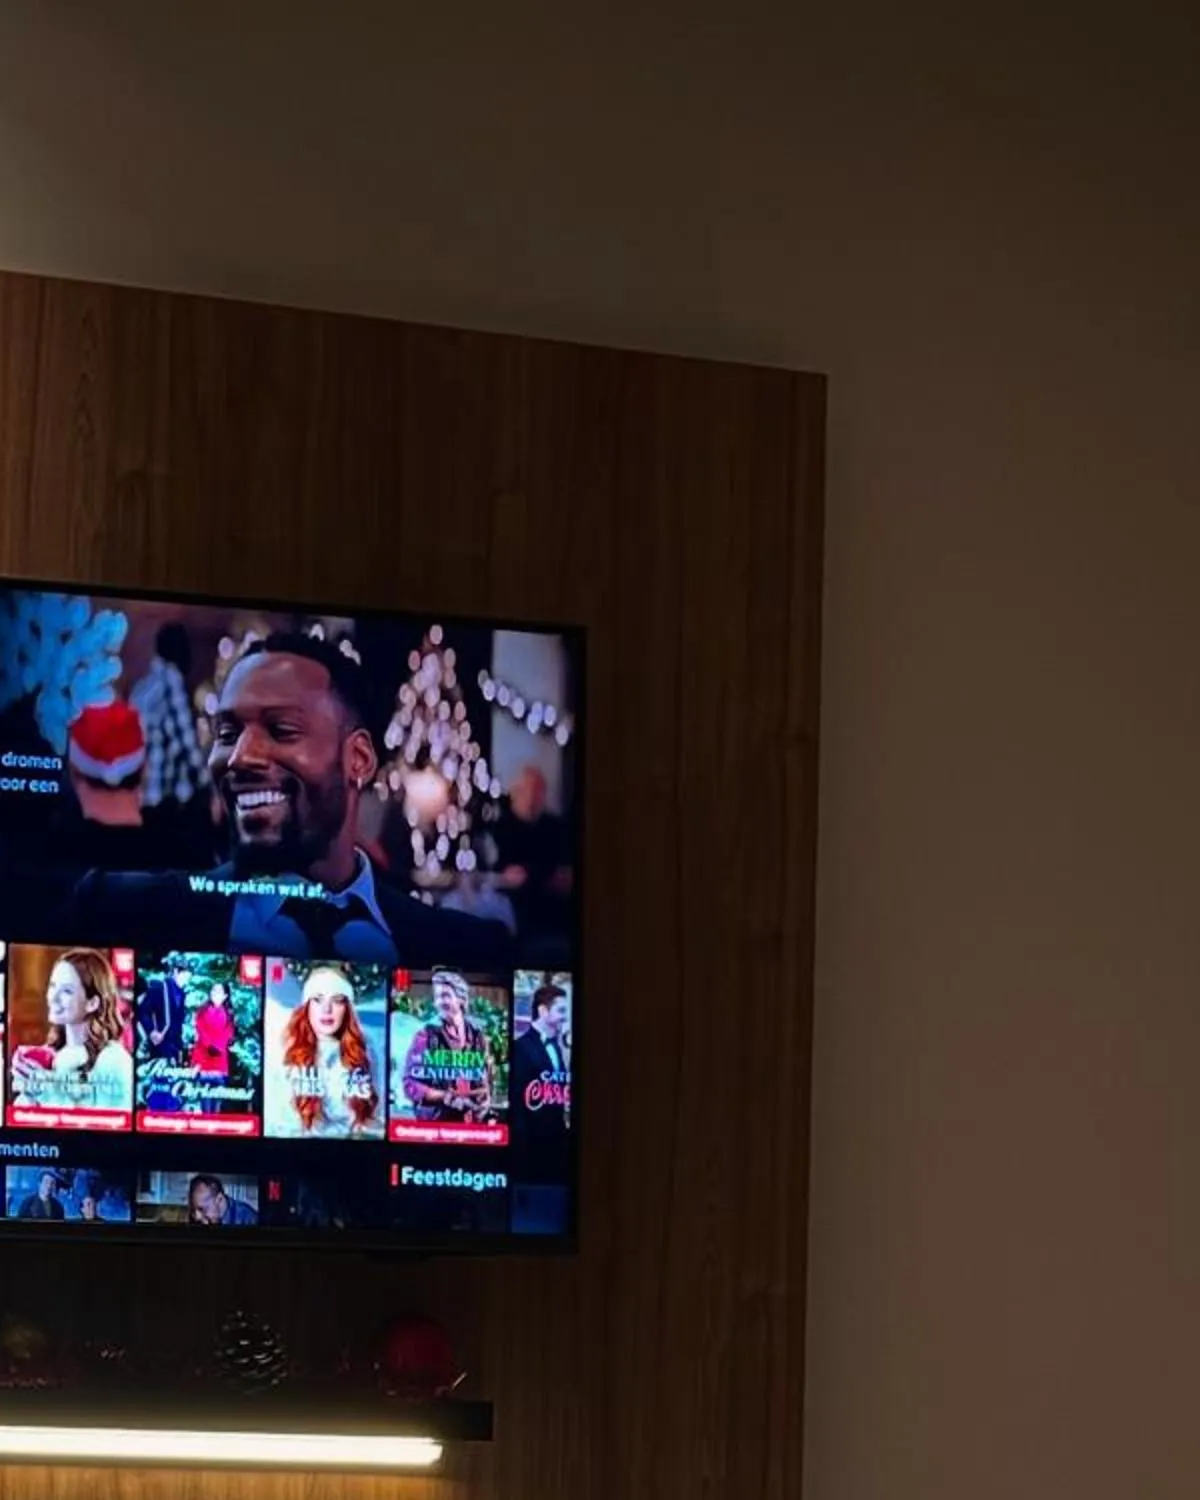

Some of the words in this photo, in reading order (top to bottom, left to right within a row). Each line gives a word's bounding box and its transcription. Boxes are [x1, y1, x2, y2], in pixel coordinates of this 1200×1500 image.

[1, 751, 62, 770] dromen
[29, 779, 60, 794] een
[189, 875, 215, 893] We
[217, 880, 275, 897] spraken
[278, 883, 304, 897] wat
[401, 1165, 507, 1192] Feestdagen
